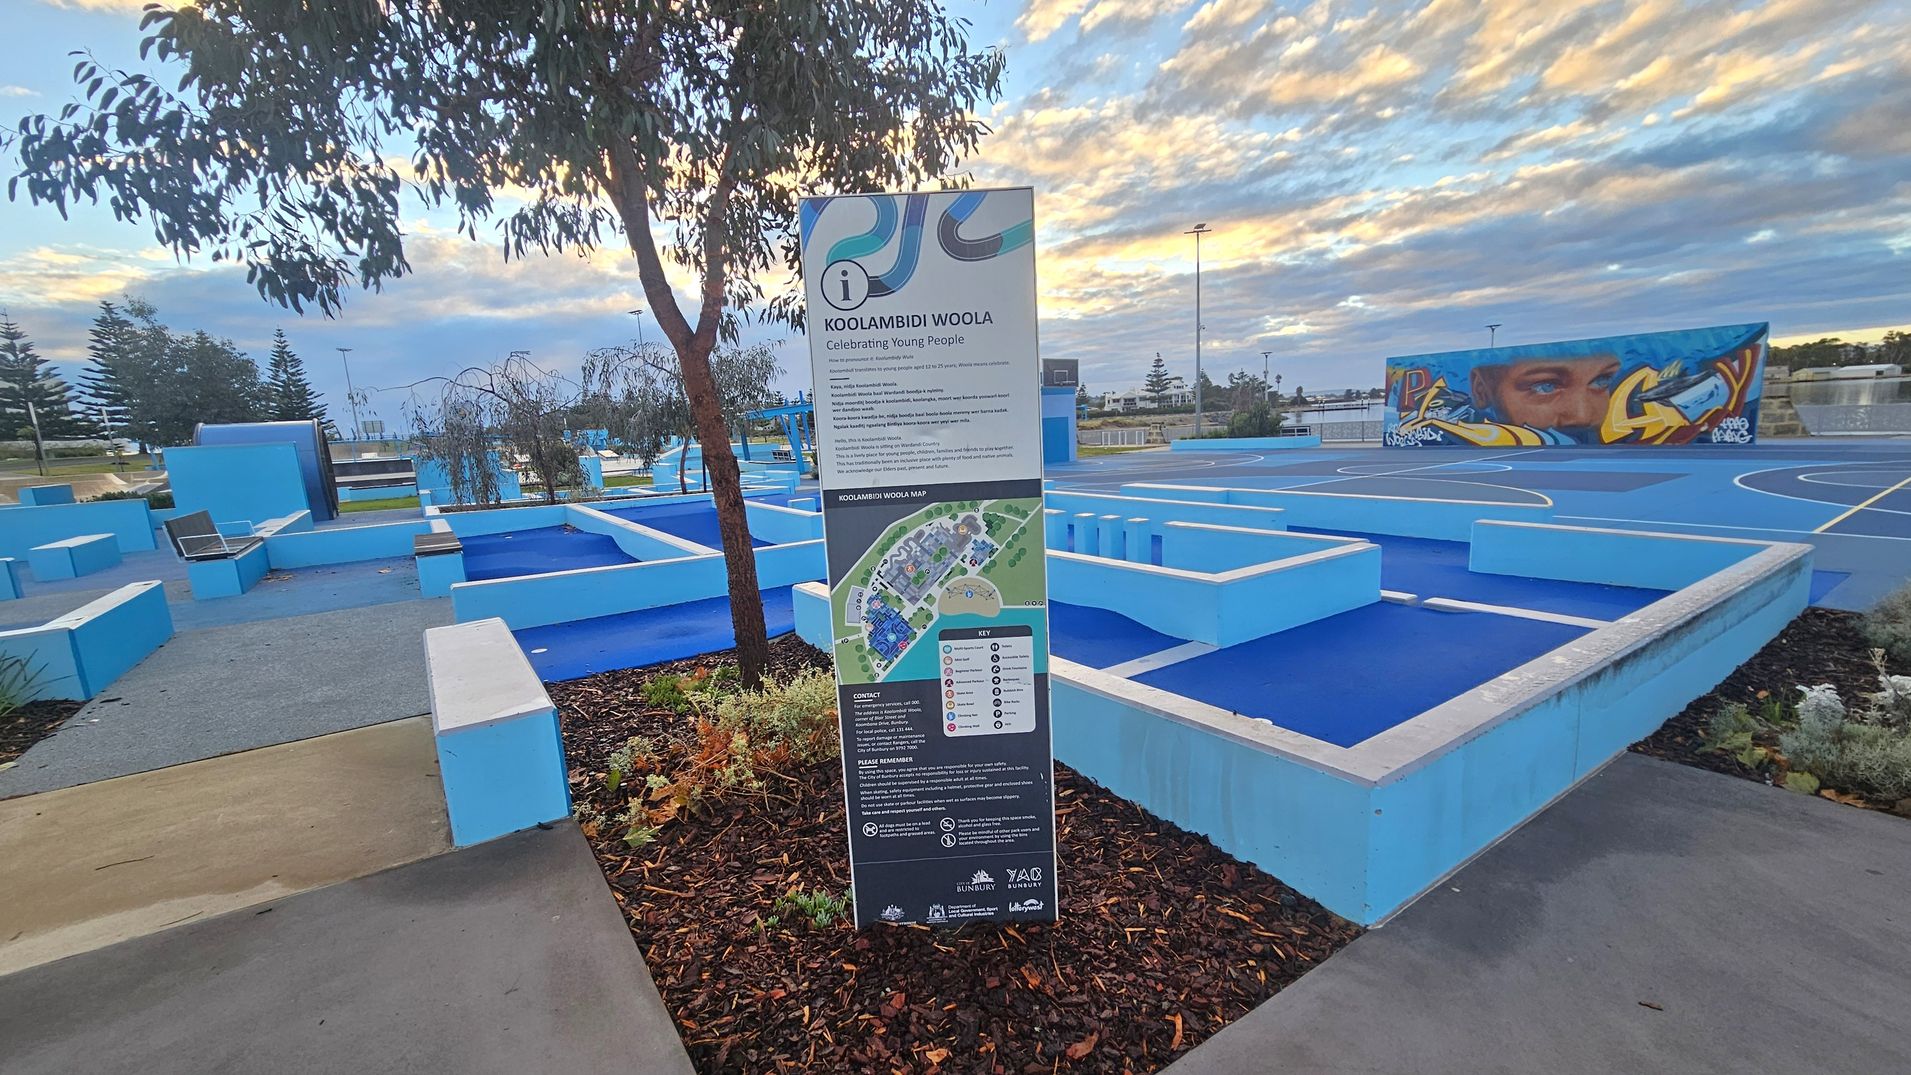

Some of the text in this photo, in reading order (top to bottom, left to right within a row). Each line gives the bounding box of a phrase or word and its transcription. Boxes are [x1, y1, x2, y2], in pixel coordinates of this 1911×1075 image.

[825, 311, 993, 331] KOOLAMBIDI WOOLA
[826, 334, 965, 350] Celebrating Young People
[839, 493, 882, 501] KOOLAMBIDI
[957, 884, 996, 892] BUNBURY
